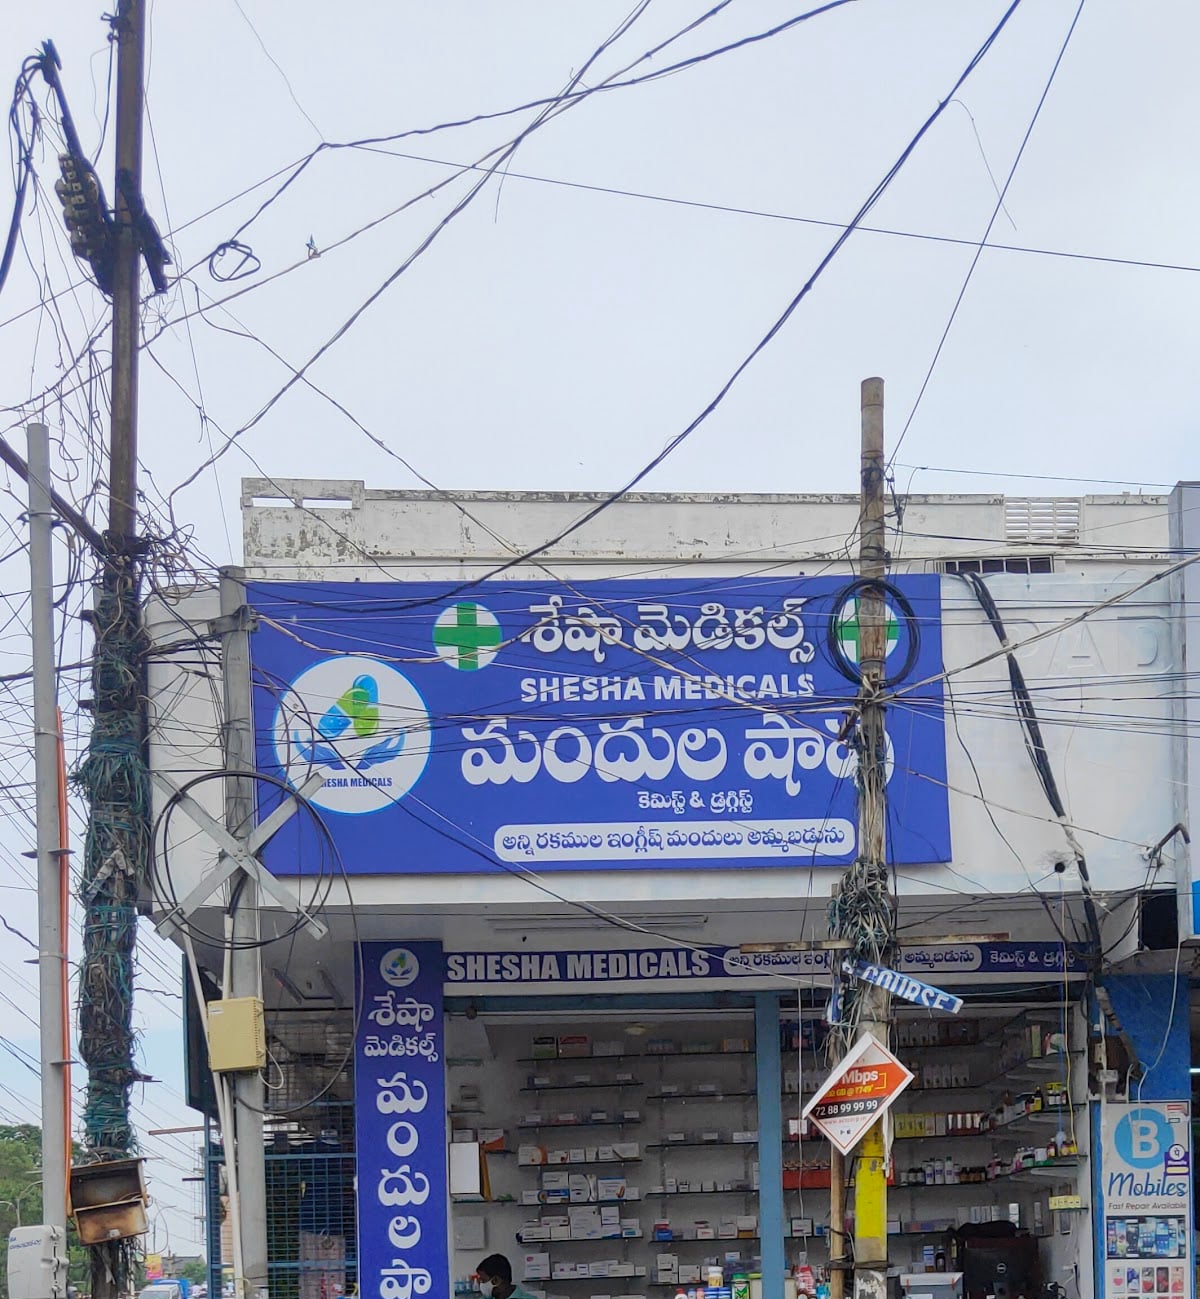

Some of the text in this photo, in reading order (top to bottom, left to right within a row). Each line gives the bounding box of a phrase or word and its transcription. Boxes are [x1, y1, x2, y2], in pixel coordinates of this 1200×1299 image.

[521, 595, 815, 664] శేషా మెడికల్స్
[521, 674, 815, 702] SHESHA MEDICALS
[461, 716, 727, 785] మందుల
[351, 777, 392, 787] MEDICALS
[689, 793, 704, 808] &
[502, 835, 535, 855] అన్ని
[536, 832, 602, 848] రకముల
[667, 830, 742, 847] మందులు
[747, 828, 845, 853] అమ్మబడును
[448, 951, 710, 980] SHESHA MEDICALS
[367, 990, 435, 1033] శేషా
[363, 1032, 439, 1063] మెడికల్స్
[841, 1070, 879, 1085] Mbps
[815, 1100, 878, 1116] 72 88 99 99 99
[1132, 1119, 1160, 1159] B
[1108, 1172, 1187, 1198] Mobiles
